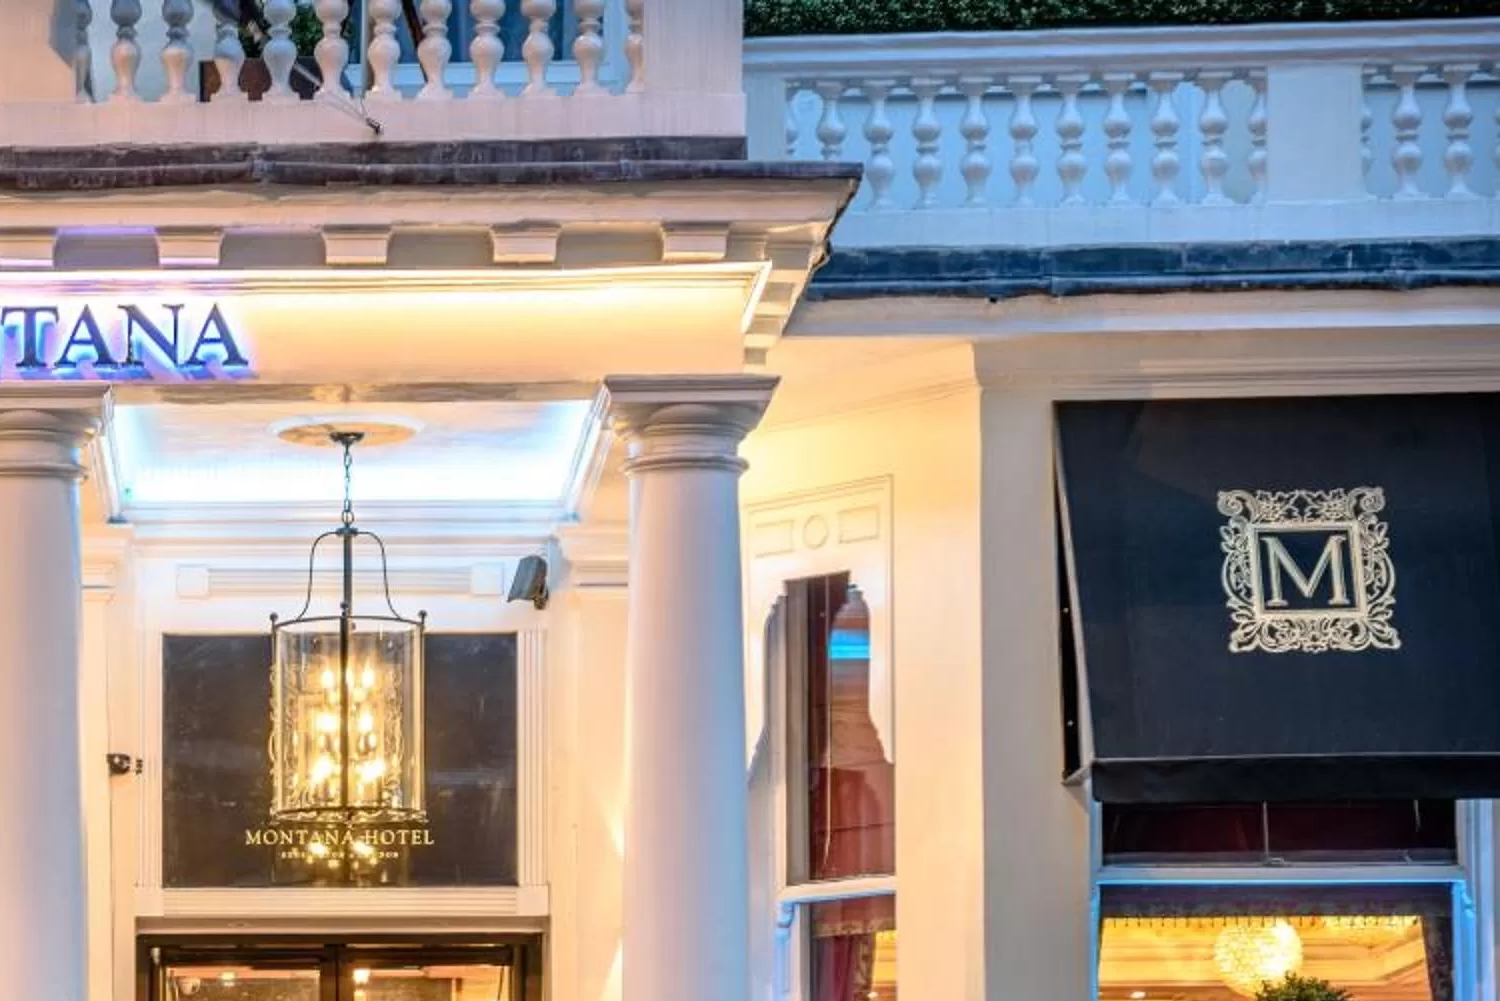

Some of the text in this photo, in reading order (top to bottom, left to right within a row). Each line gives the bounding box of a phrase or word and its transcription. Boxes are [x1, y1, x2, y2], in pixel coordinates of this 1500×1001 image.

[1259, 534, 1348, 607] M
[245, 829, 435, 845] MONTANA HOTEL
